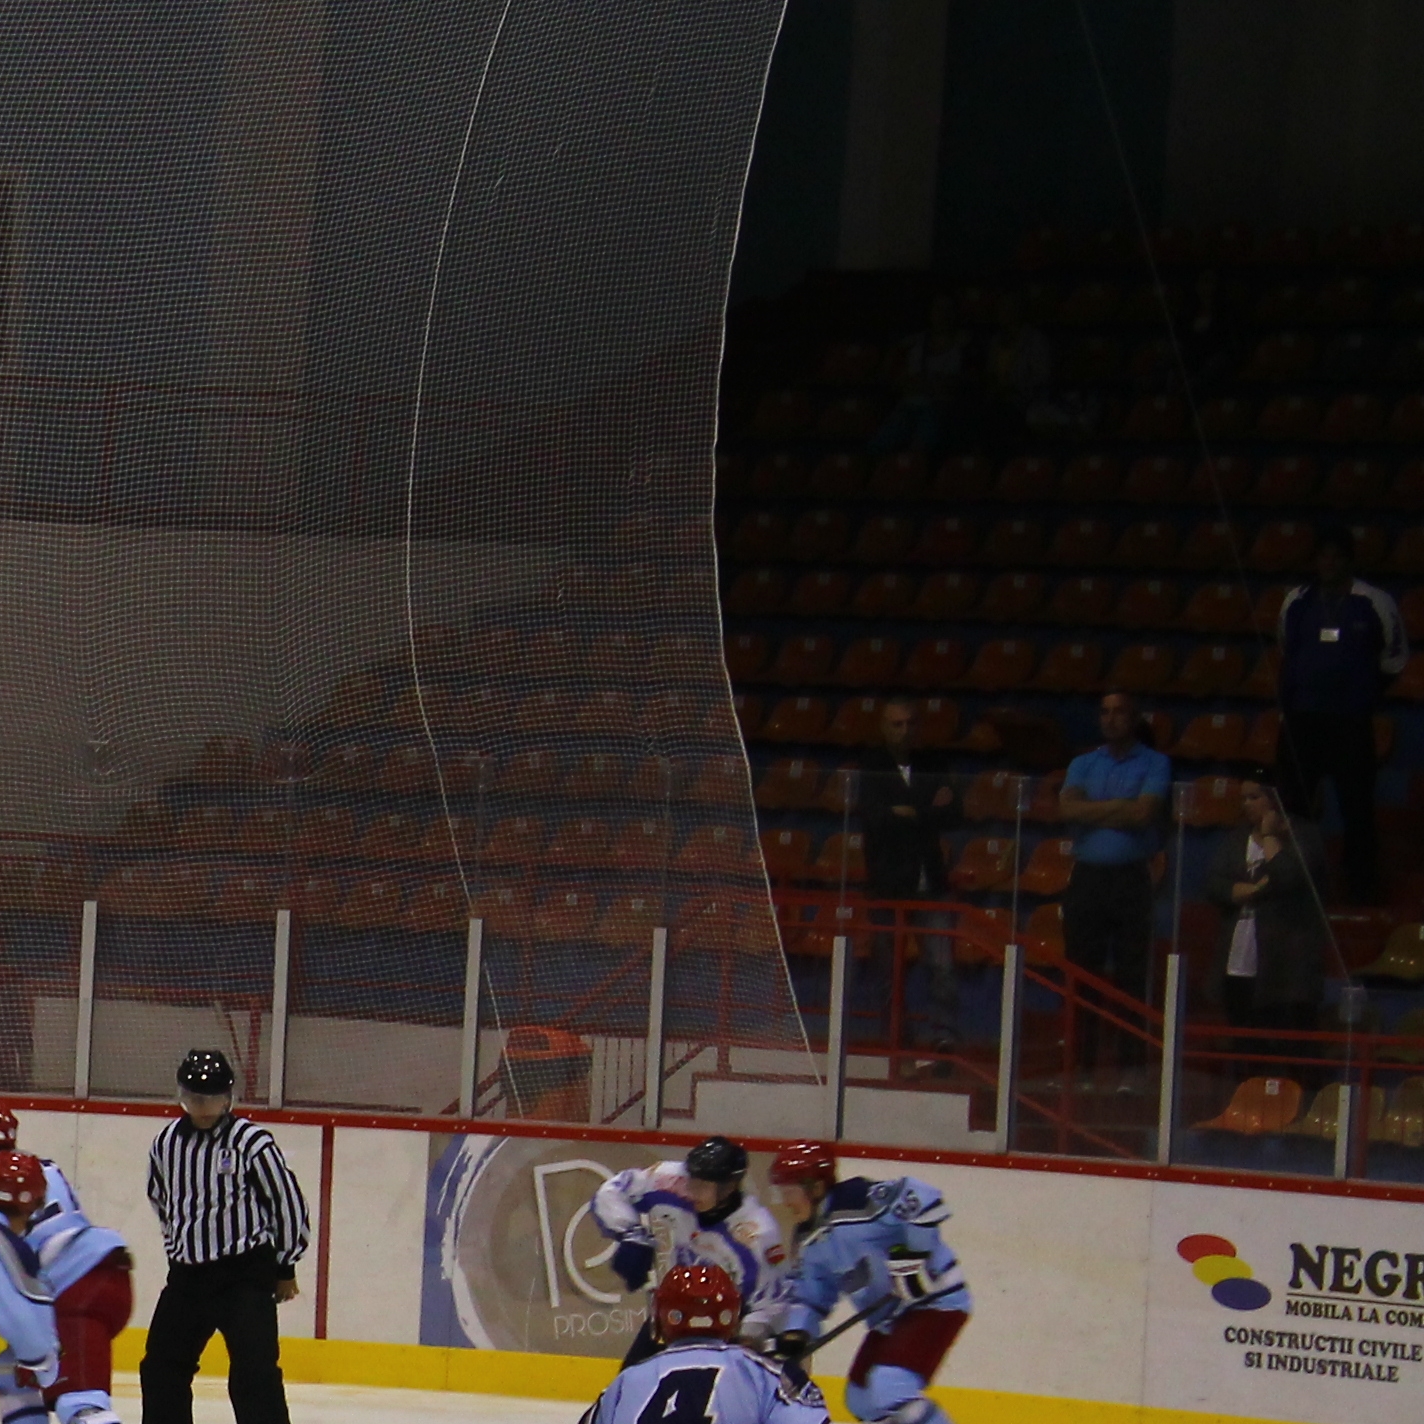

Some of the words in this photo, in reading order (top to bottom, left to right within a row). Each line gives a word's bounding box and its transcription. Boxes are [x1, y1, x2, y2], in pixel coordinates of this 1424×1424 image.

[1285, 1300, 1353, 1321] MOBILA
[1357, 1307, 1380, 1324] LA
[1224, 1326, 1354, 1355] CONSTRUCTII
[1358, 1340, 1424, 1362] CIVILE
[1245, 1352, 1262, 1369] SI
[1267, 1354, 1400, 1383] INDUSTRIALE
